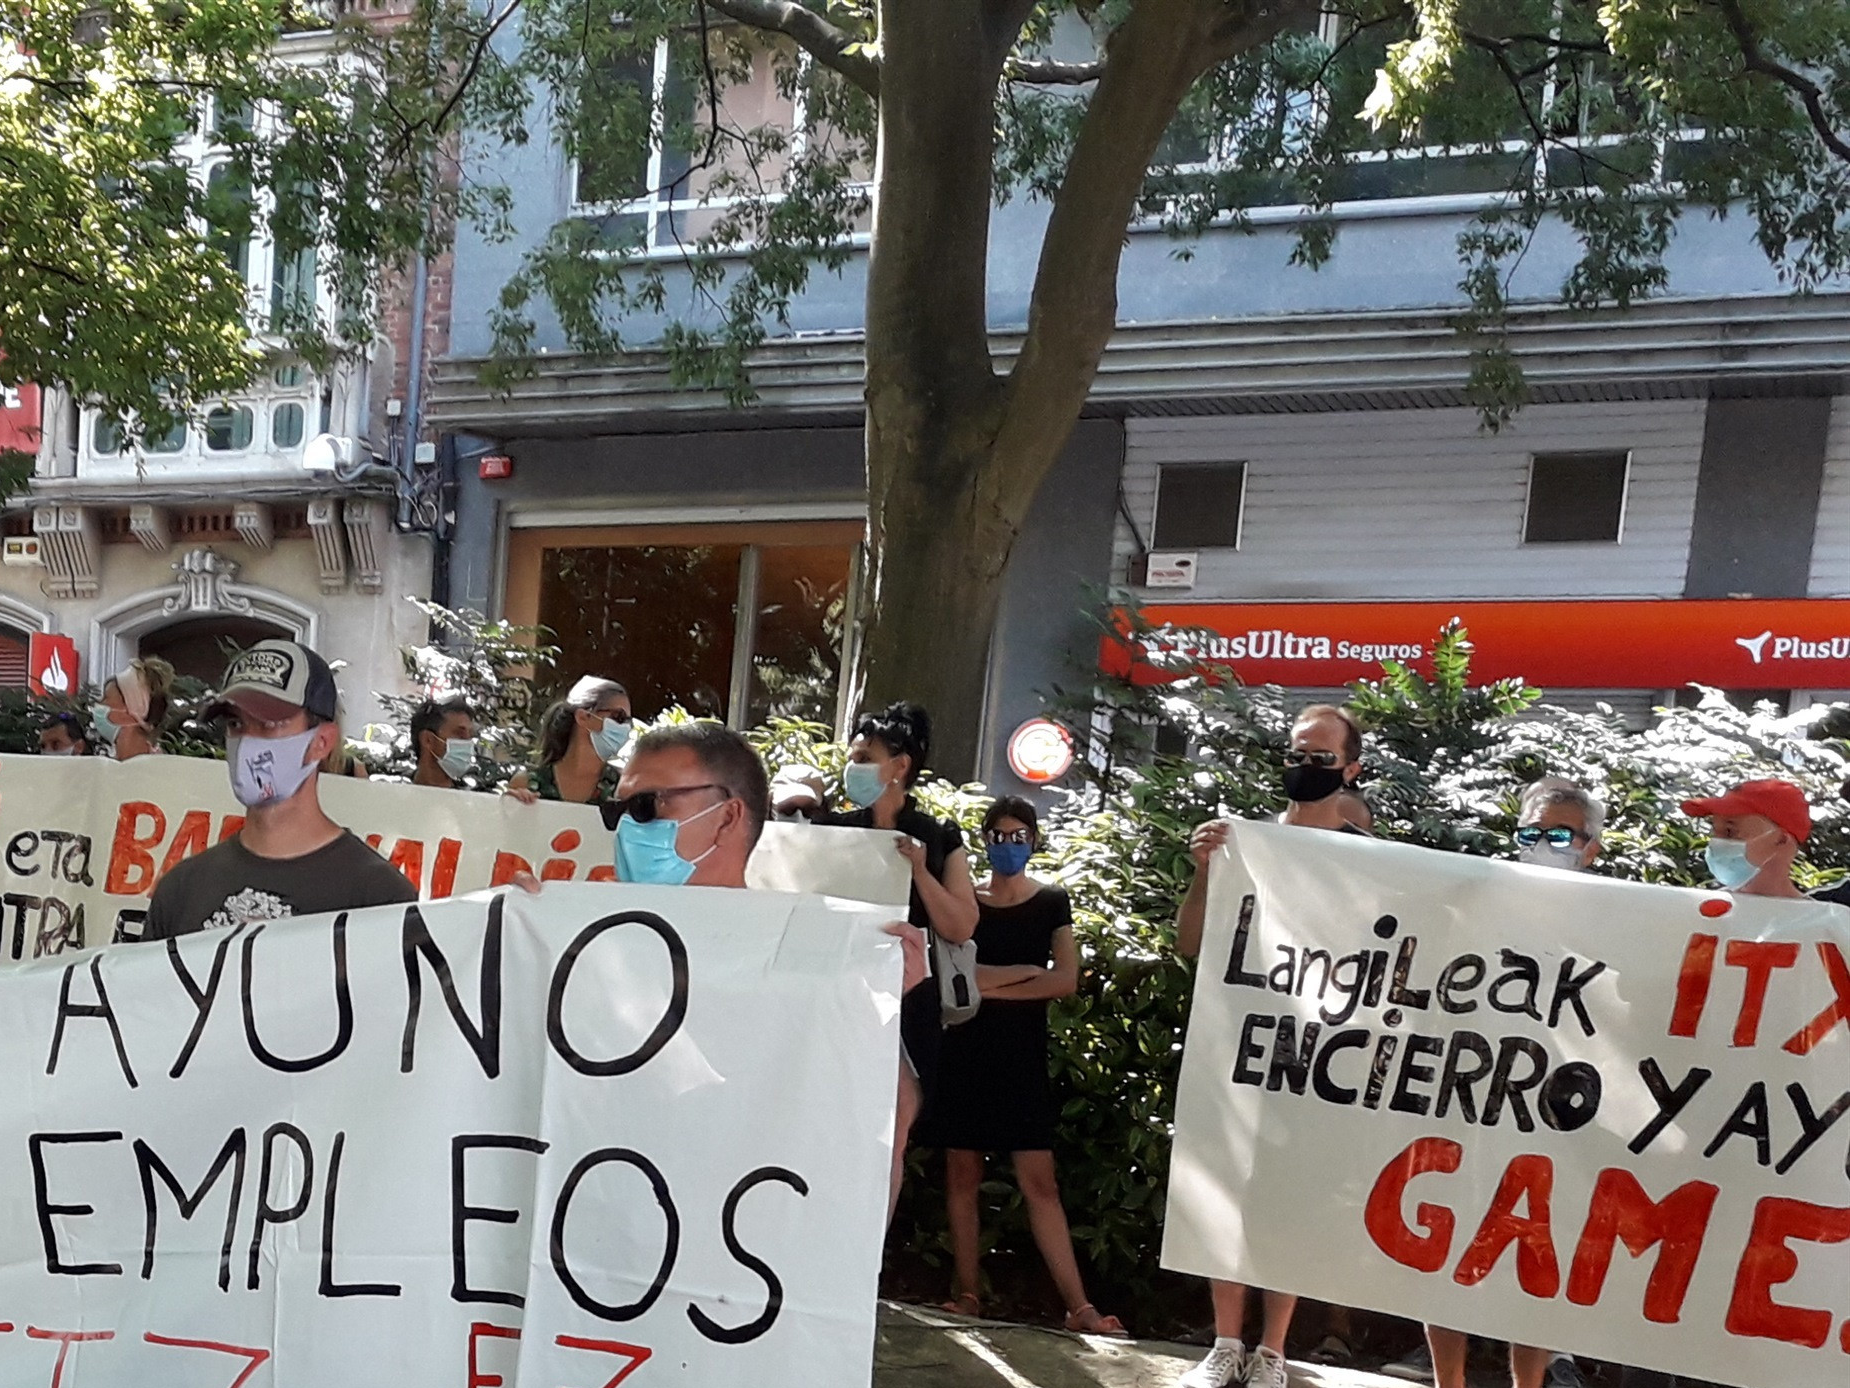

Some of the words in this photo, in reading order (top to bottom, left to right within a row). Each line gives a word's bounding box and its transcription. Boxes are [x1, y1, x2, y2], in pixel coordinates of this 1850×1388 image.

[1336, 640, 1423, 662] Seguros
[1771, 635, 1850, 659] PlusU
[45, 892, 689, 1091] AYUNO
[1626, 1056, 1713, 1156] Y
[1702, 1080, 1850, 1178] AY
[29, 1122, 809, 1345] EMPLEOS
[1363, 1136, 1850, 1354] GAME
